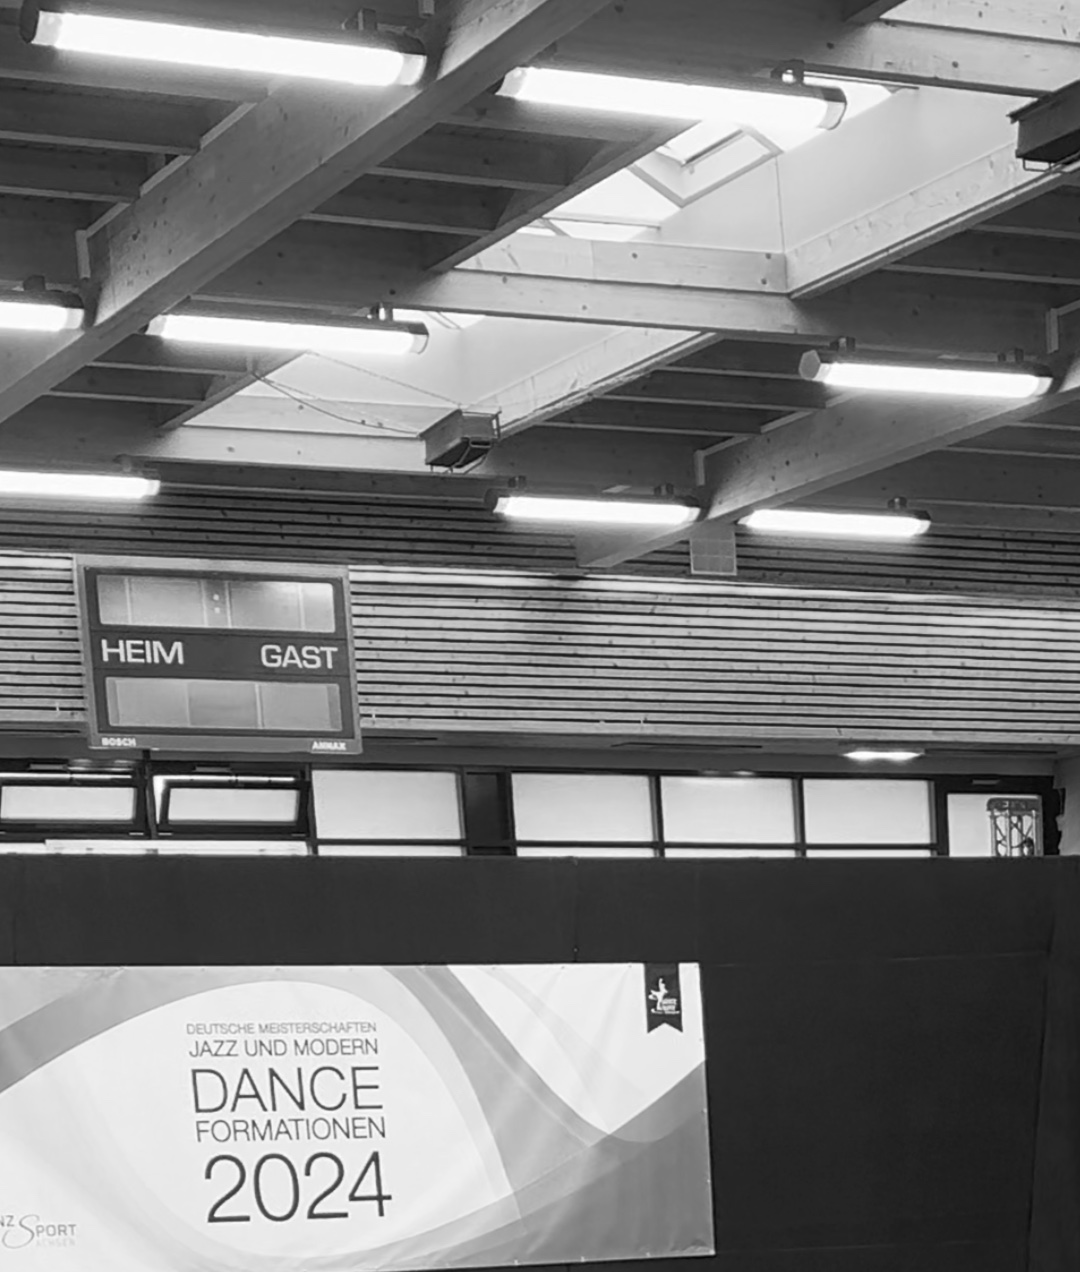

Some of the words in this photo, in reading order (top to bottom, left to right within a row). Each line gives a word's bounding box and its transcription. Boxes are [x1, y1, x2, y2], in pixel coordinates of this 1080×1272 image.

[101, 639, 184, 665] HEIM
[260, 644, 339, 669] GAST
[101, 737, 137, 748] BOSCH
[186, 1023, 256, 1035] DEUTSCHE
[258, 1022, 377, 1034] MEISTERSCHAFTEN
[188, 1040, 239, 1057] JAZZ
[244, 1039, 288, 1056] UND
[293, 1038, 379, 1056] MODERN
[191, 1065, 384, 1113] DANCE
[195, 1117, 386, 1142] FORMATIONEN
[204, 1150, 393, 1223] 2024
